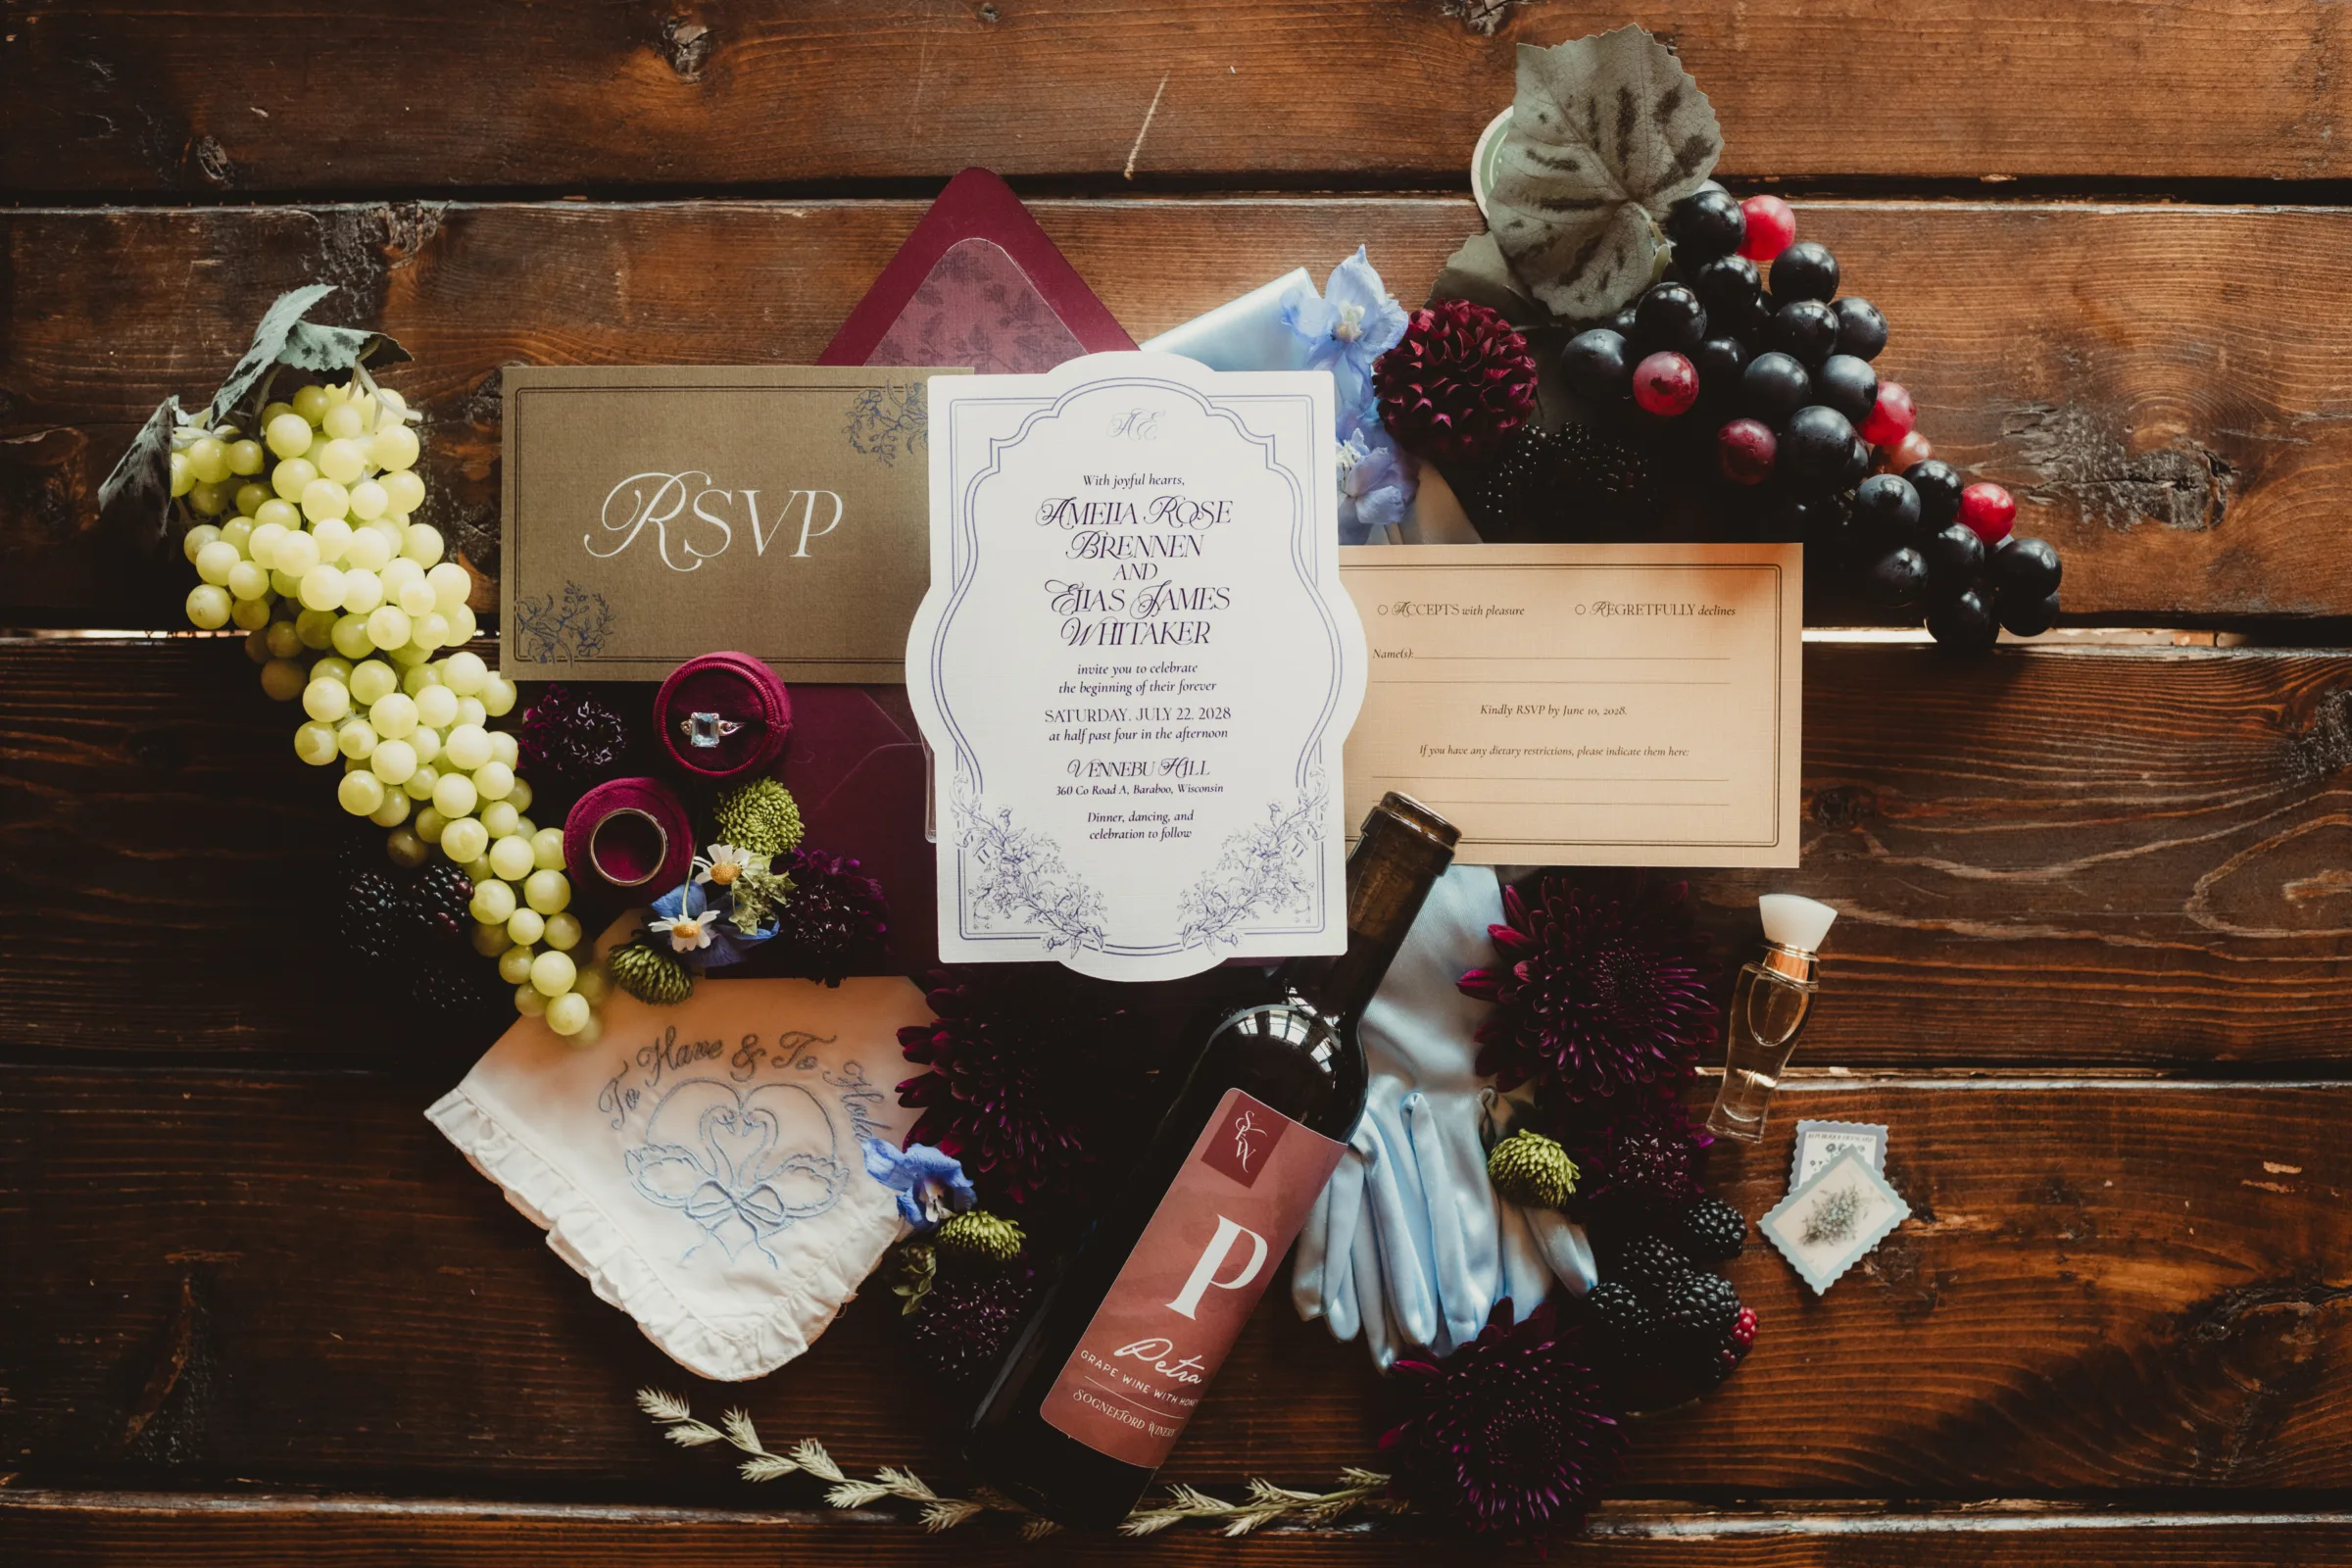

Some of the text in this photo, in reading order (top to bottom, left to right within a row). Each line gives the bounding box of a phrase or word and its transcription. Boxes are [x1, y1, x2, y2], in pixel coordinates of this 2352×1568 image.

[1083, 472, 1185, 490] With joyful hearts,
[583, 470, 843, 572] RSVP
[1035, 495, 1233, 530] AMELIA ROSE
[1065, 530, 1204, 560] BRENNEN
[1112, 563, 1158, 581] AND
[1044, 579, 1231, 619] ELIAS JAMES
[1392, 601, 1525, 618] ACCEPTS with pleasure
[1589, 601, 1737, 617] REGRETFULLY declines
[1060, 616, 1211, 647] WHITAKER
[1372, 648, 1414, 660] Name(s):
[1077, 661, 1198, 678] invite you to celebrate
[1058, 678, 1217, 697] the beginning of their forever
[1135, 707, 1172, 721] JULY
[1199, 707, 1232, 720] 2028
[1480, 704, 1513, 717] Kindly
[1516, 705, 1545, 714] RSVP
[1547, 704, 1560, 718] by
[1562, 705, 1585, 716] June
[1587, 708, 1599, 716] 10,
[1063, 727, 1088, 745] half
[1088, 731, 1111, 745] past
[1112, 727, 1138, 744] four
[1141, 728, 1152, 740] in
[1155, 727, 1173, 739] the
[1175, 726, 1228, 743] afternoon
[1419, 744, 1690, 759] If you have any dietary restrictions, please indicate them here:
[1067, 757, 1210, 779] VENNEBU HILL
[1055, 783, 1224, 796] 360 Co Road A, Baraboo, Wisconsin
[1087, 809, 1195, 824] Dinner, dancing, and
[1089, 826, 1193, 842] celebration to follow
[598, 1060, 640, 1130] To
[636, 1024, 724, 1088] Have
[729, 1034, 767, 1082] &
[771, 1031, 837, 1071] To
[1164, 1213, 1268, 1321] P
[1113, 1338, 1205, 1385] Petra
[1080, 1349, 1119, 1378] GRAPE
[1122, 1374, 1152, 1394] WINE
[1153, 1389, 1179, 1404] WITH
